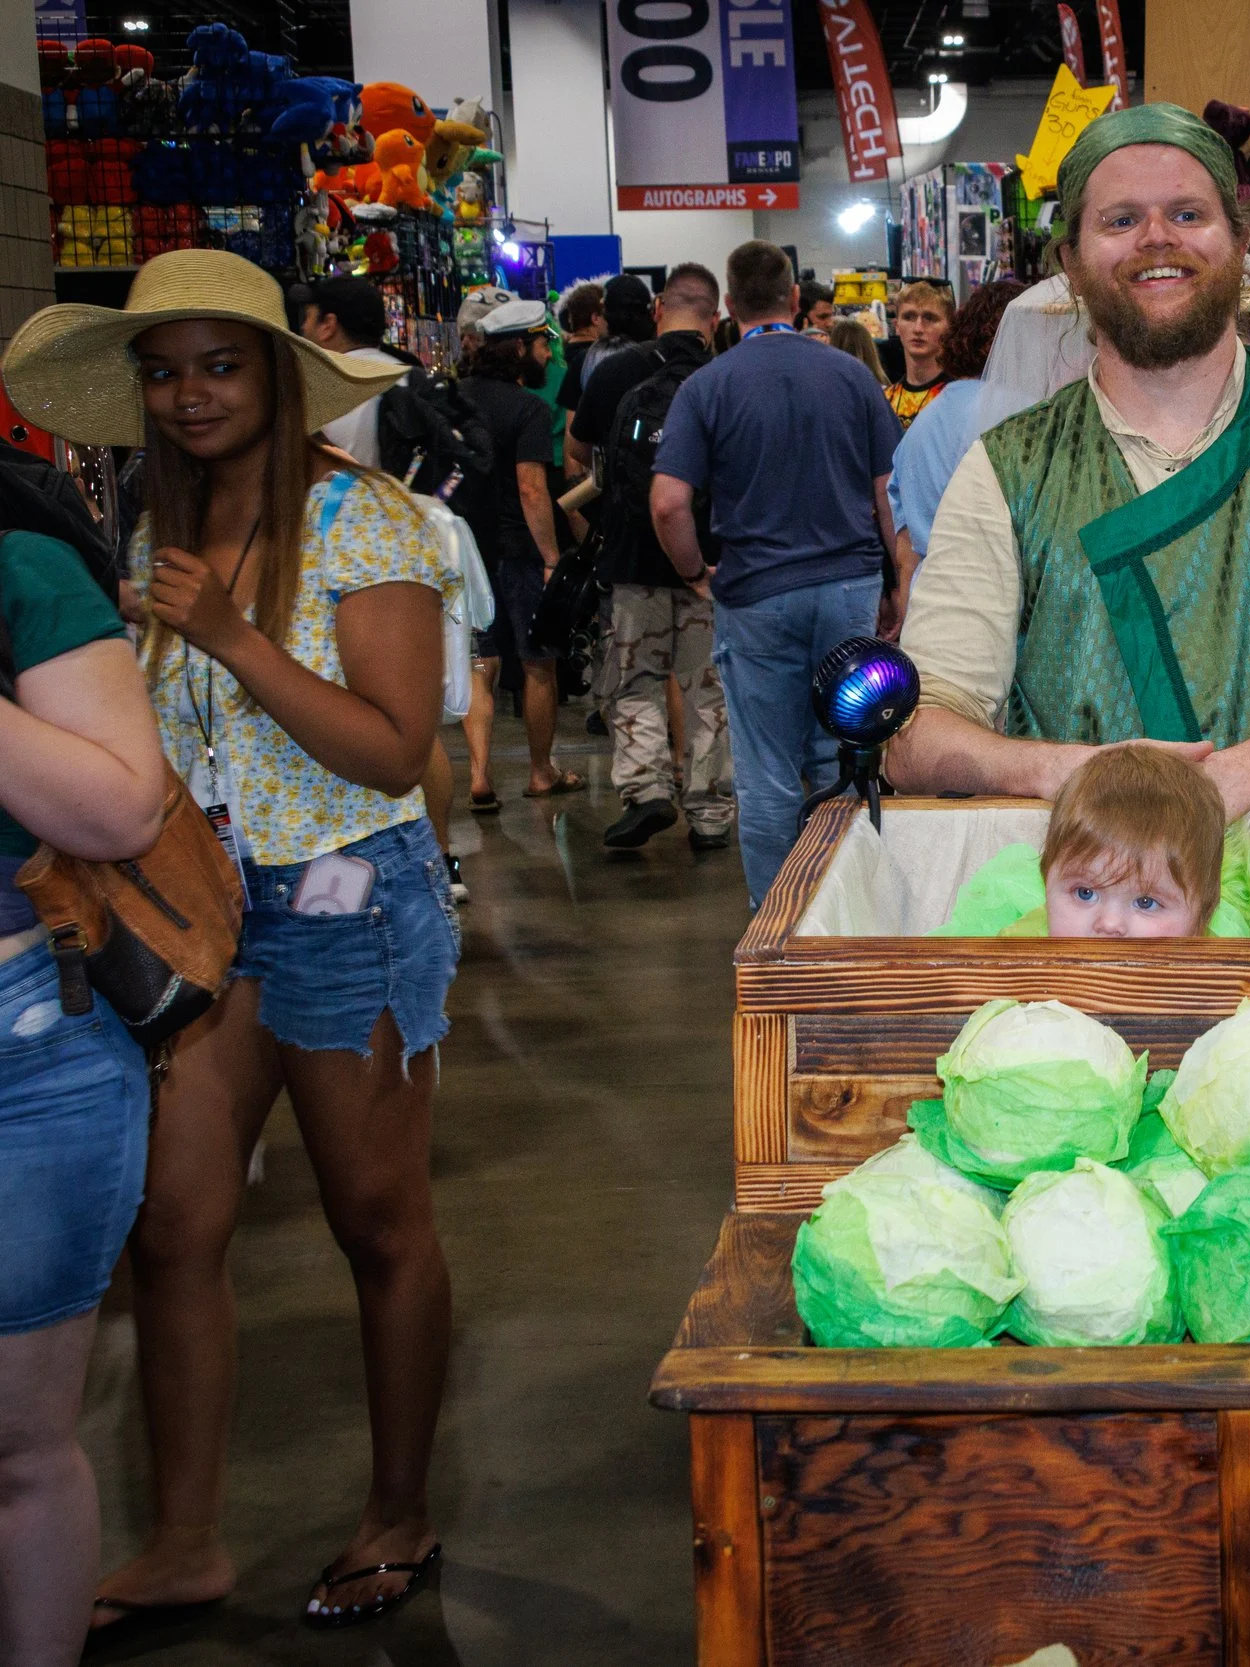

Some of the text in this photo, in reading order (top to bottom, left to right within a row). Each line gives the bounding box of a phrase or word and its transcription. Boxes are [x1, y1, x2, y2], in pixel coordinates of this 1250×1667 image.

[727, 0, 787, 67] LE
[1050, 91, 1100, 119] Guns
[643, 189, 747, 208] AUTOGRAPHS
